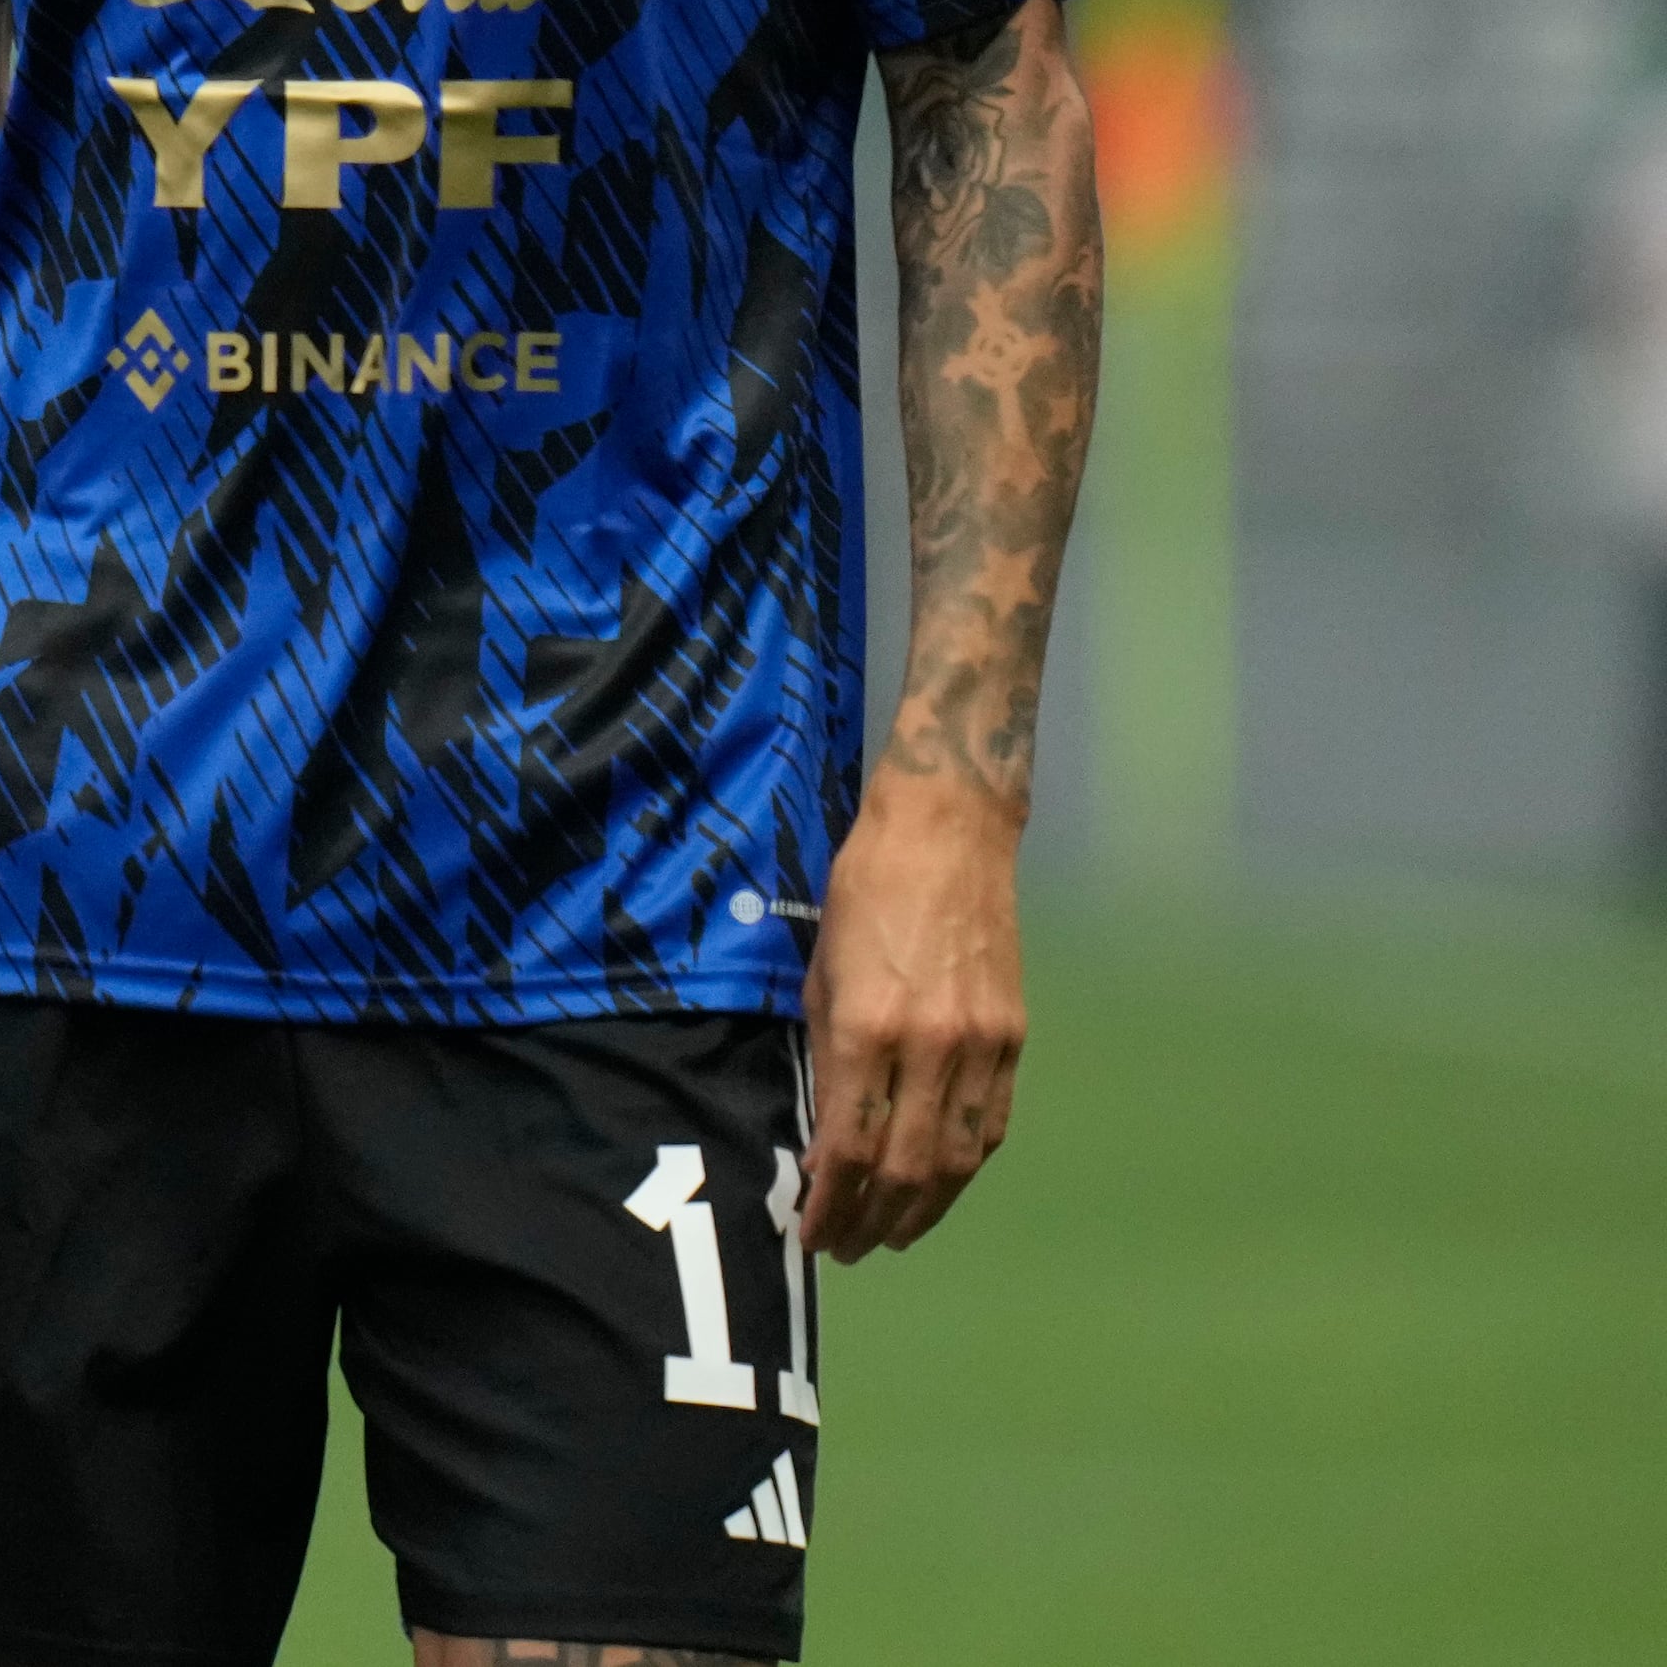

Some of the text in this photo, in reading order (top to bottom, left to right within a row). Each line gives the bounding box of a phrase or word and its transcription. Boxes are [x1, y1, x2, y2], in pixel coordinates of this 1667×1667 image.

[105, 76, 574, 210] YPF
[205, 330, 562, 394] BINANCE
[622, 1143, 821, 1428] 11
